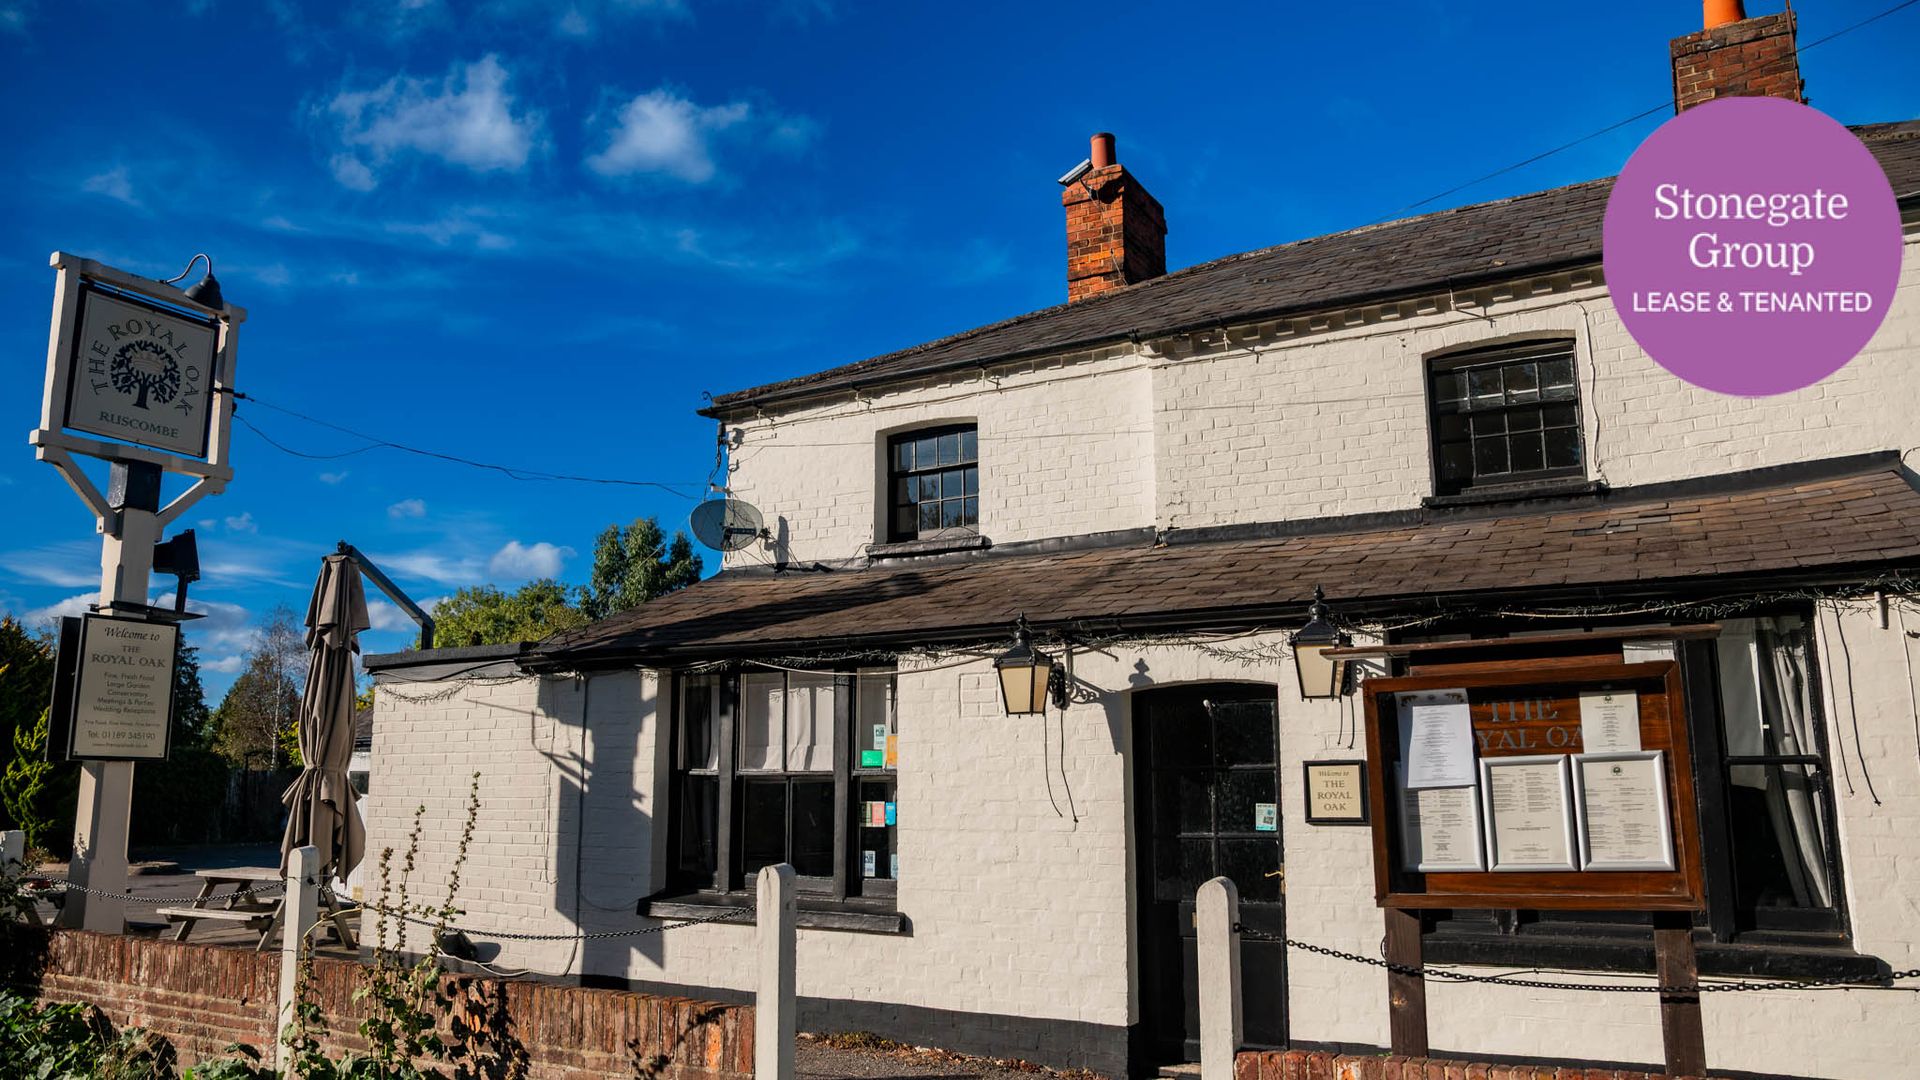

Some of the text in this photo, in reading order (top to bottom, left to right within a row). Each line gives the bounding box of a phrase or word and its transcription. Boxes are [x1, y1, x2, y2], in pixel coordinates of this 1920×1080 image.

[89, 319, 200, 416] THE ROYAL OAK
[99, 411, 179, 438] RUSCOMBE
[104, 627, 160, 641] Welcome to
[122, 645, 141, 653] THE
[91, 653, 166, 668] ROYAL OAK
[1475, 728, 1536, 751] YAL
[1323, 780, 1345, 788] THE
[1317, 791, 1353, 800] ROYAL
[1323, 803, 1347, 811] OAK
